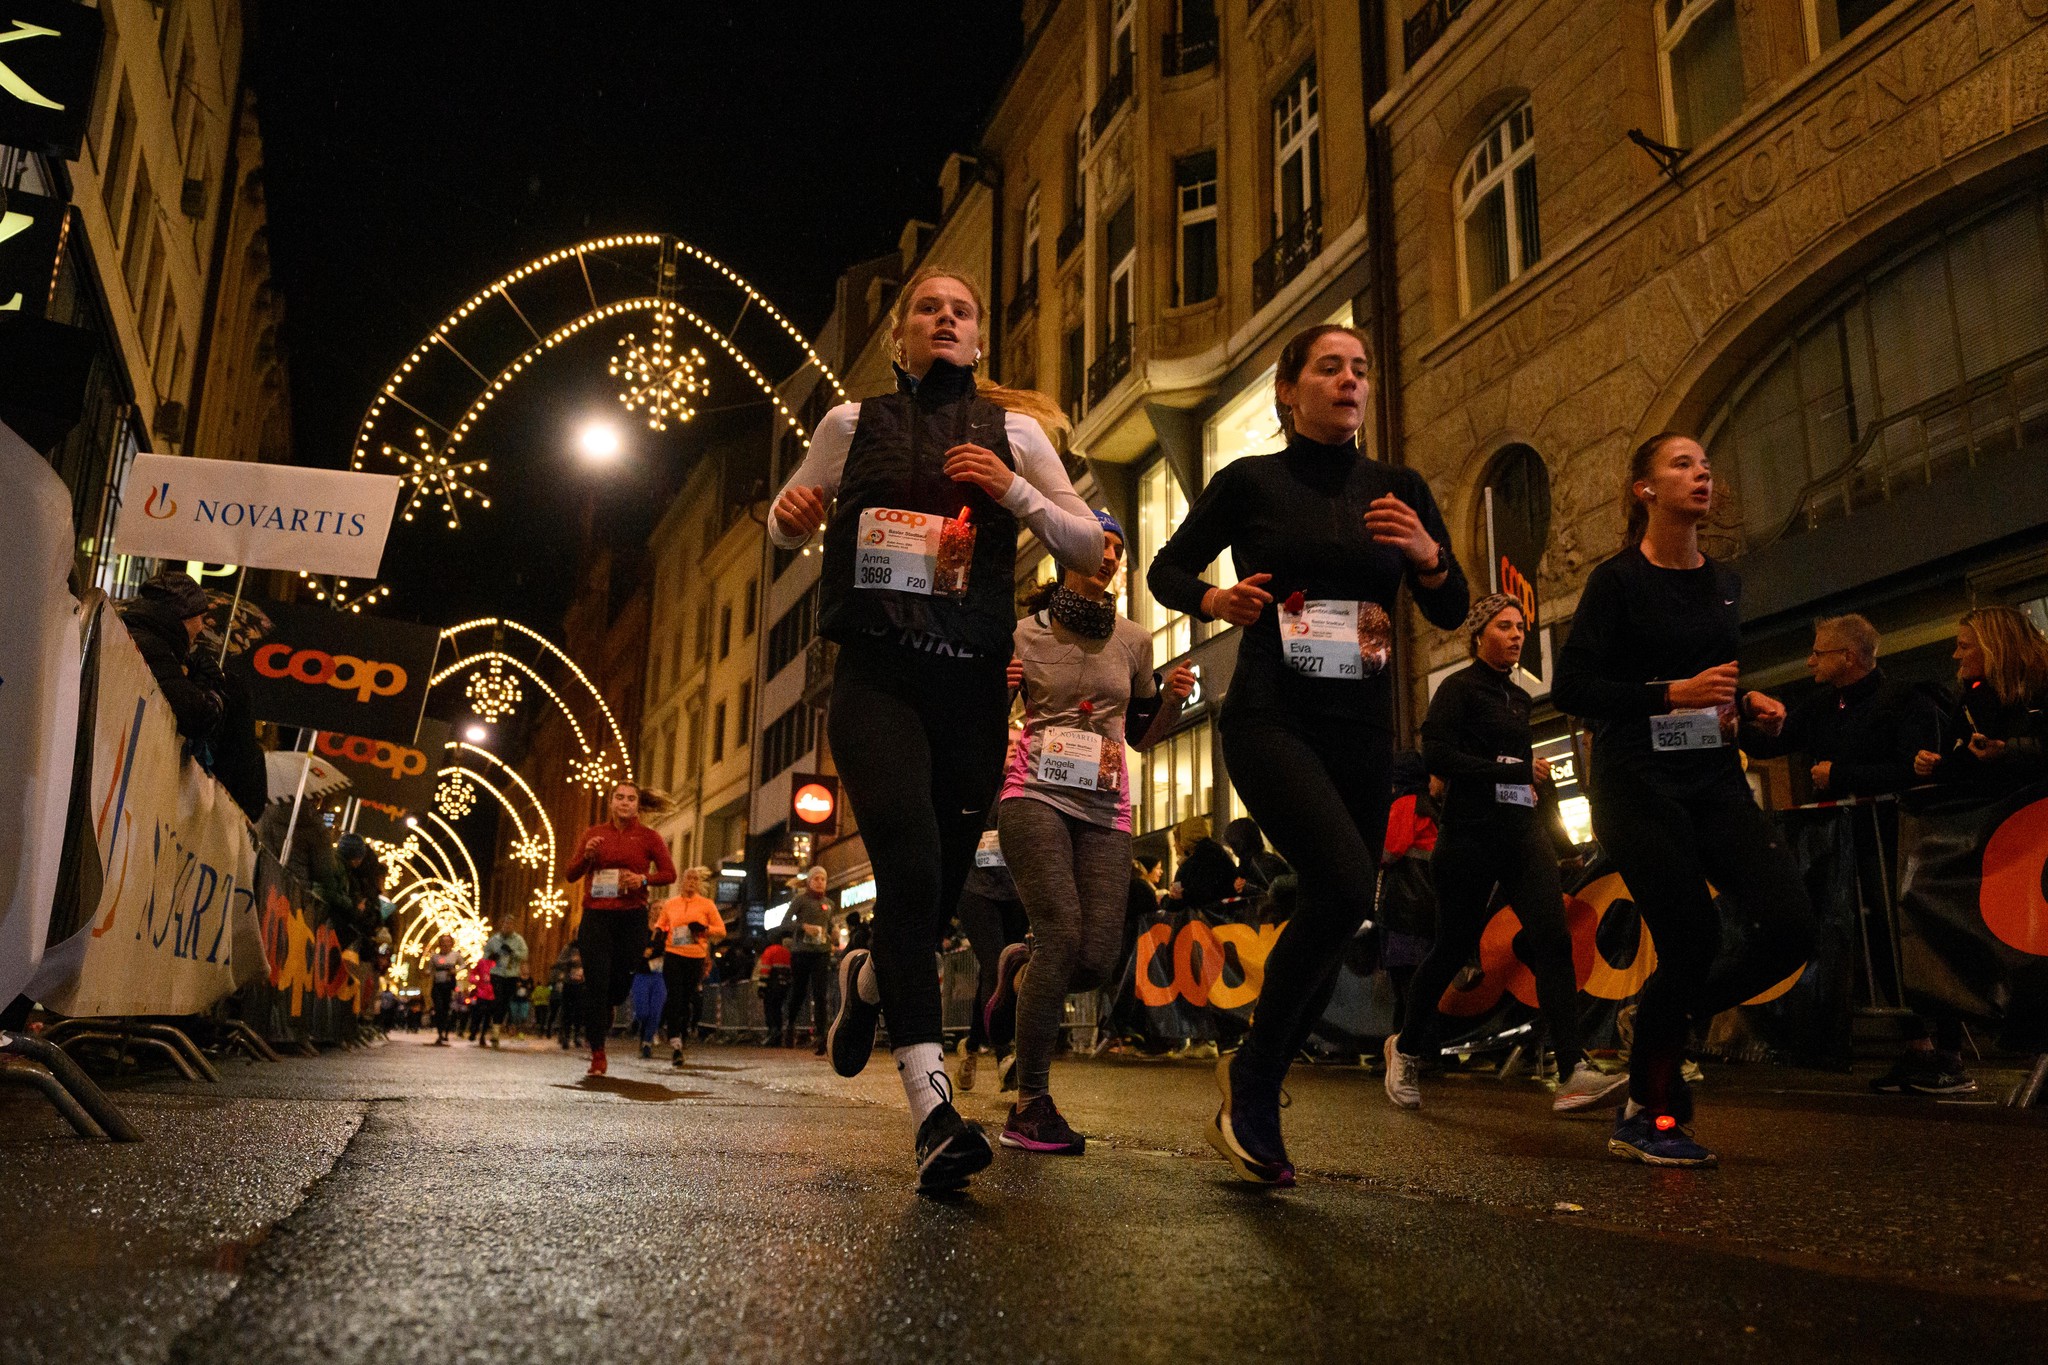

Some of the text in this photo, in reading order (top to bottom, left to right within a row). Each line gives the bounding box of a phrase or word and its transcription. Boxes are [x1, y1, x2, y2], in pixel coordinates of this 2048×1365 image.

[1463, 279, 1578, 389] HAUS
[1597, 226, 1690, 309] ZUM
[1707, 54, 1923, 234] ROTEN
[194, 499, 366, 537] NOVARTIS
[875, 509, 927, 528] coop
[861, 553, 890, 565] Anna
[861, 566, 927, 589] 3698 F20
[1290, 642, 1312, 653] Eva
[253, 643, 408, 702] coop
[1290, 656, 1357, 675] 5227 F20
[1656, 720, 1693, 731] Mirjam
[1060, 731, 1098, 743] NOVARTIS
[1658, 732, 1717, 746] 5251 F20
[316, 732, 427, 780] coop
[1044, 757, 1075, 770] Angela
[1043, 766, 1093, 787] 1794 F30
[1135, 919, 1292, 1020] coo
